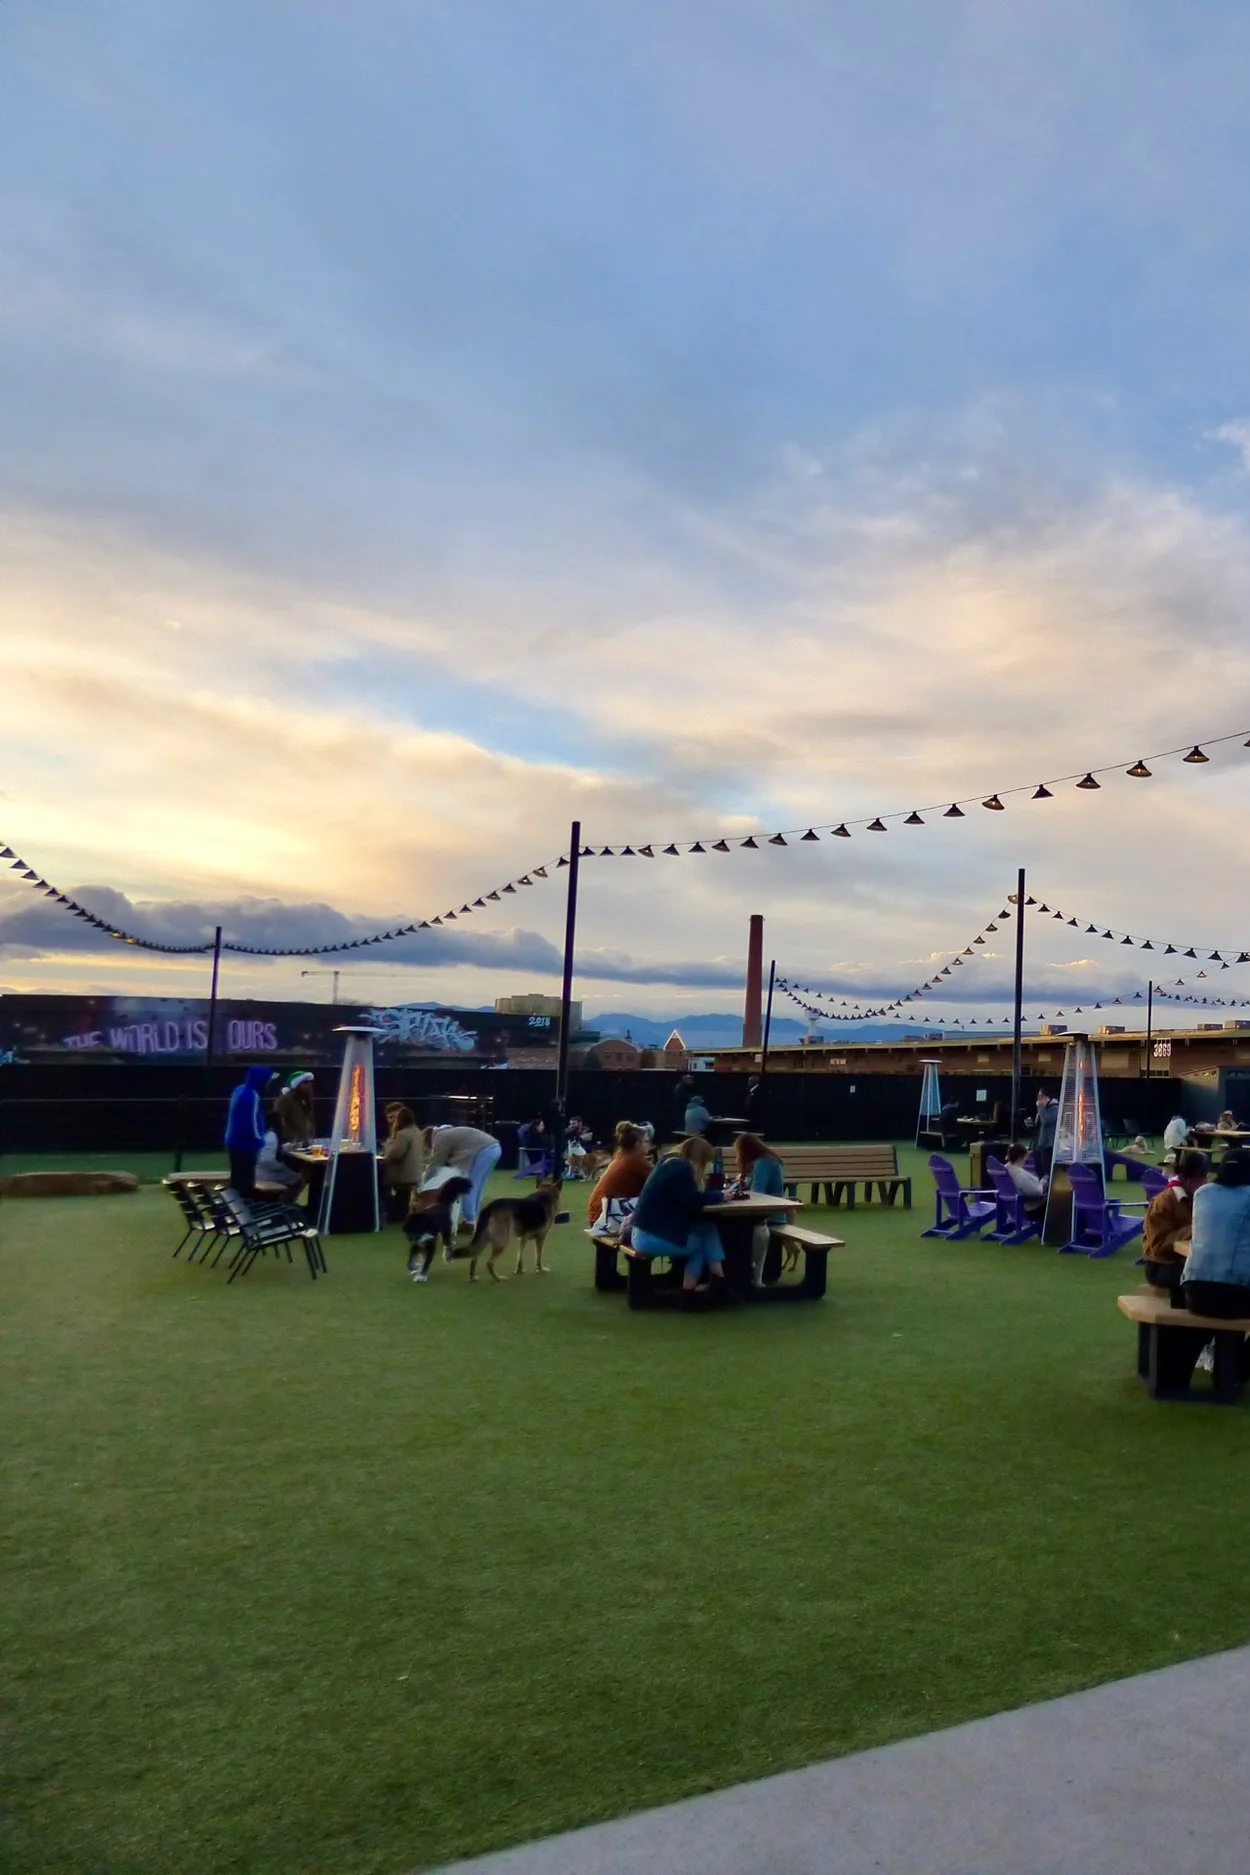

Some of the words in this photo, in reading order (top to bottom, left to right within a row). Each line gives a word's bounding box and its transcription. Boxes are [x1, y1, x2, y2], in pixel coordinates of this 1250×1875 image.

[528, 1016, 551, 1027] 2018
[110, 1022, 180, 1054] WORLD
[187, 1021, 208, 1049] IS
[228, 1019, 277, 1050] OURS
